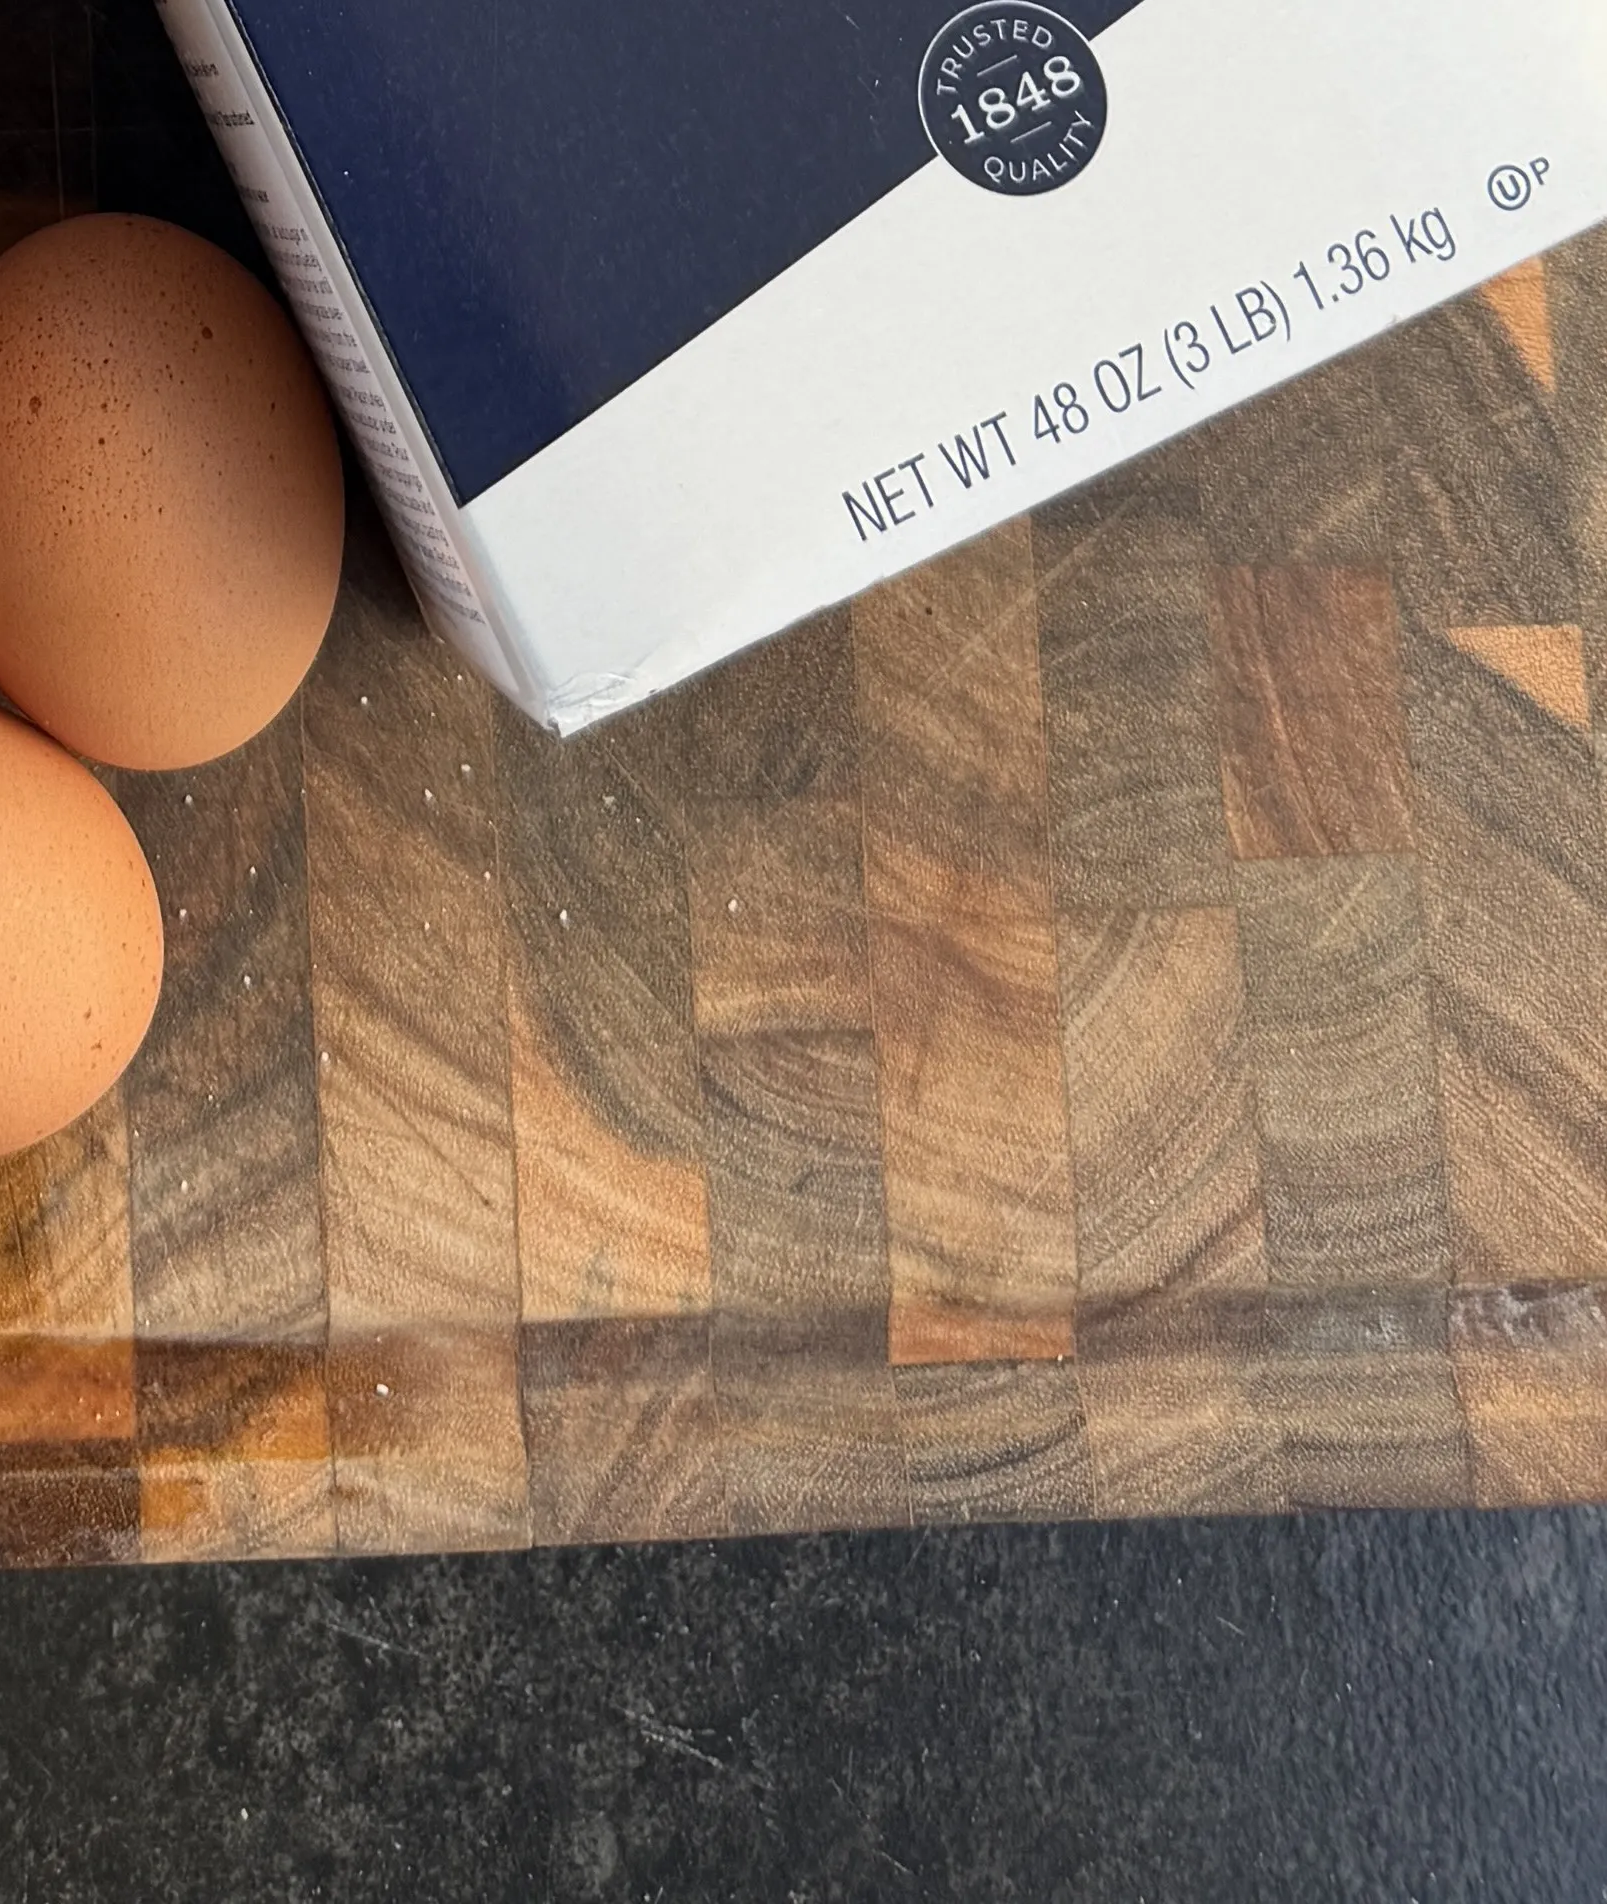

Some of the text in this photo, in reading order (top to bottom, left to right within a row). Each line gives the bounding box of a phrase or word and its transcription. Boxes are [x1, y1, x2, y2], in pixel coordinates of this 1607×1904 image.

[936, 18, 1052, 95] TRUSTED
[950, 55, 1081, 144] 1848
[983, 110, 1091, 183] QUALITY
[842, 207, 1456, 541] NET WT 48 OZ (3 LB) 1.36 kg
